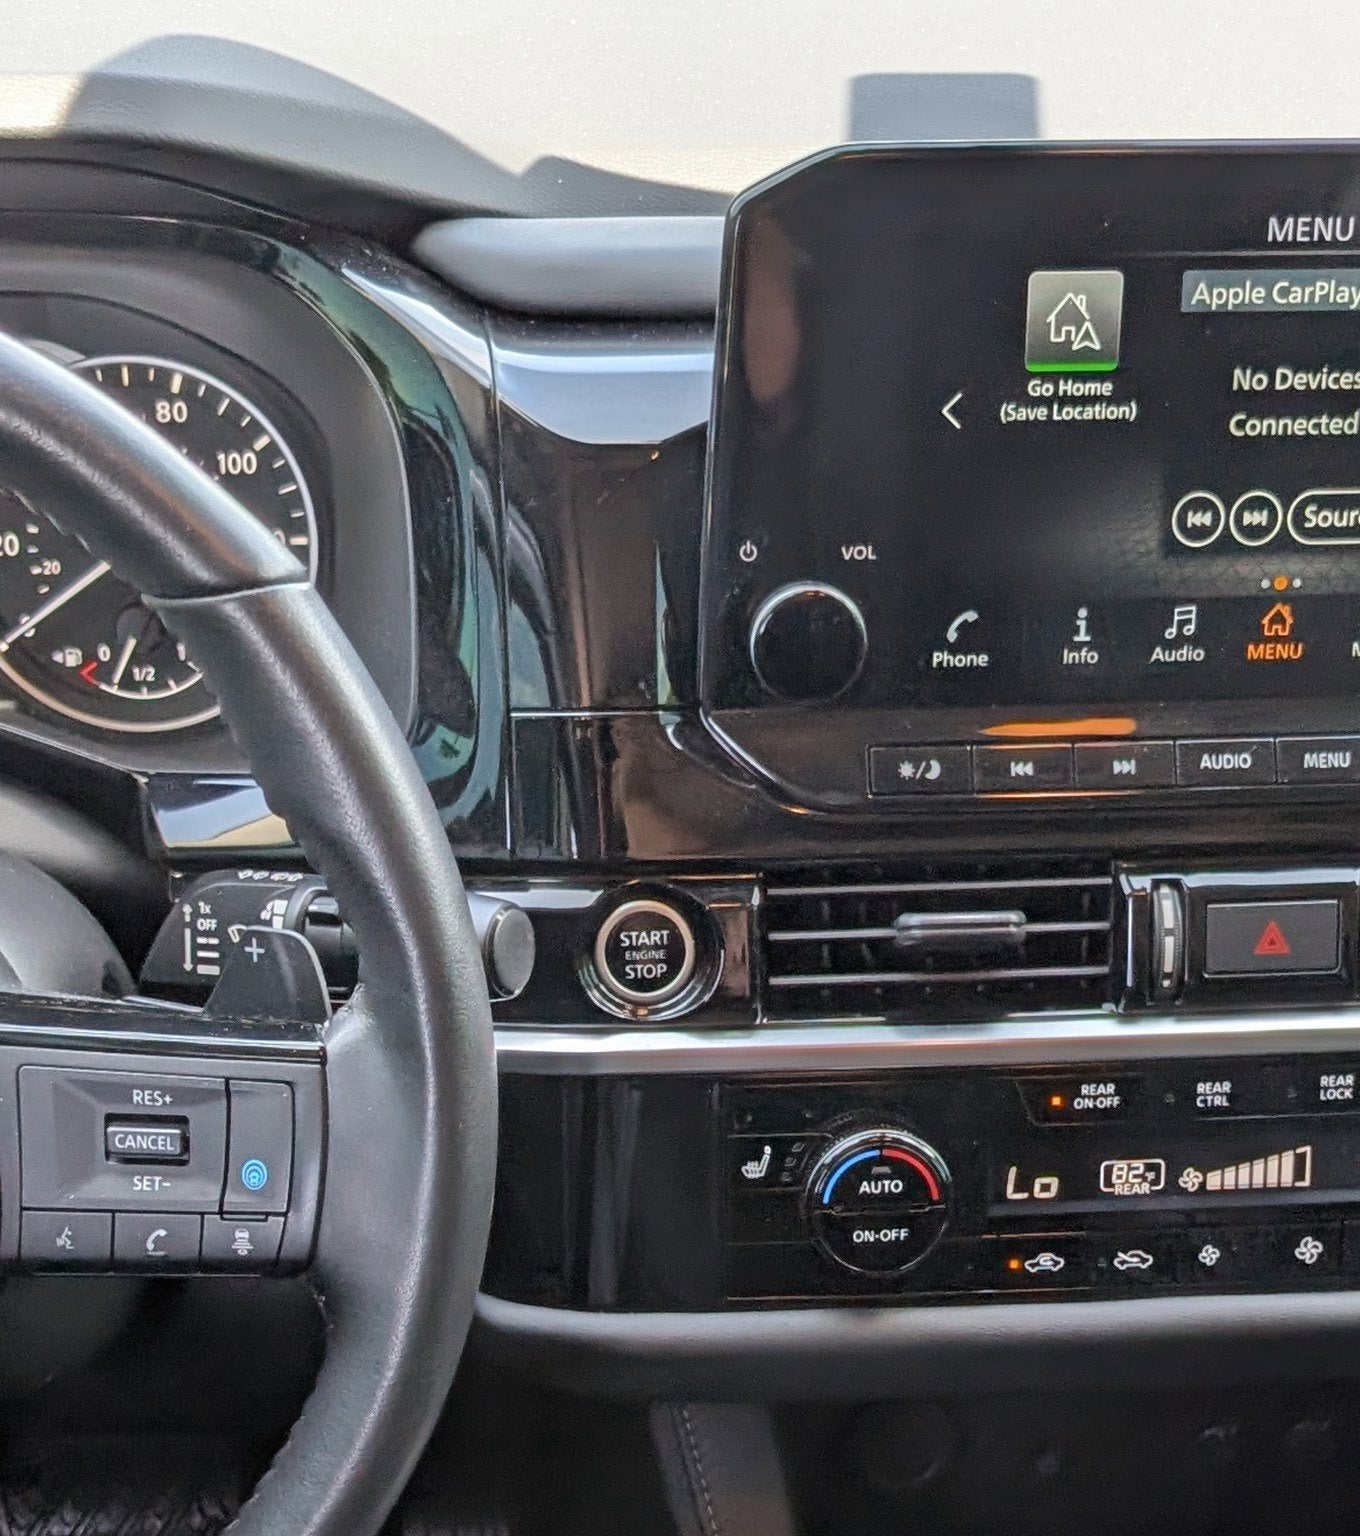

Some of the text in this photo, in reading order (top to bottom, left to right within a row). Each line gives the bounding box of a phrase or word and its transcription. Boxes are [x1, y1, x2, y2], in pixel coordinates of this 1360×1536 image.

[1267, 215, 1355, 243] MENU
[1190, 280, 1266, 310] Apple
[1232, 366, 1272, 392] No
[1027, 378, 1113, 398] Go Home
[155, 401, 188, 423] 80
[1000, 401, 1137, 423] (Save Location)
[1229, 410, 1360, 438] Connected
[217, 453, 257, 475] 100
[841, 545, 877, 561] VOL
[97, 643, 111, 662] 0
[932, 651, 989, 668] Phone
[1062, 648, 1099, 665] Info
[1150, 645, 1205, 663] Audio
[1246, 642, 1304, 660] MENU
[132, 665, 155, 681] 1/2
[1200, 752, 1251, 770] AUDIO
[1304, 751, 1351, 769] MENU
[196, 918, 217, 931] OFF
[620, 930, 670, 947] START
[625, 950, 666, 960] ENGINE
[625, 964, 667, 979] STOP
[1081, 1083, 1116, 1096] REAR
[1197, 1081, 1232, 1095] REAR
[1320, 1075, 1355, 1087] REAR
[132, 1090, 173, 1107] RES+
[1196, 1095, 1230, 1108] CTRL
[1319, 1086, 1354, 1101] LOCK
[115, 1134, 175, 1150] CANCEL
[858, 1179, 903, 1194] AUTO
[1006, 1166, 1059, 1200] Lo
[1114, 1183, 1152, 1195] REAR
